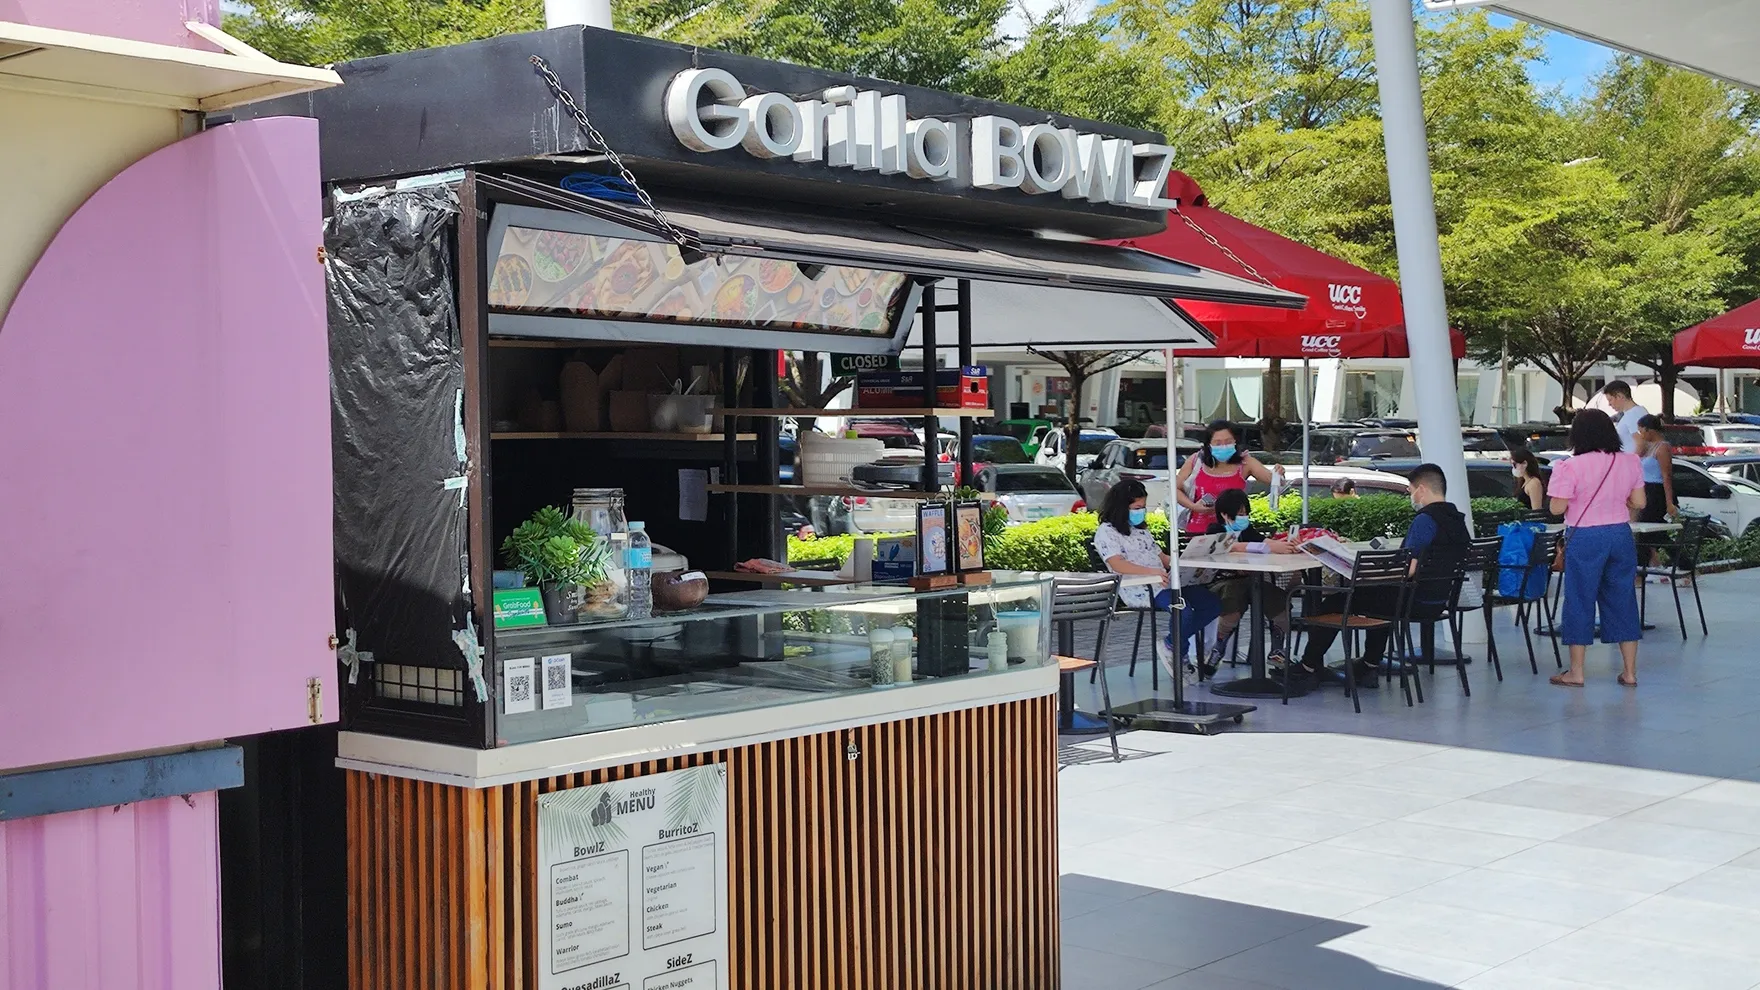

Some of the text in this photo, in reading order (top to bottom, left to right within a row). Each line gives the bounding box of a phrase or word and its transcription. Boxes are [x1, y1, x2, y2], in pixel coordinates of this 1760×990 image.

[667, 67, 1178, 210] Gorilla BOWLZ
[1328, 283, 1362, 304] UCC
[1301, 335, 1341, 348] UCC
[841, 355, 888, 370] CLOSED
[923, 510, 944, 518] WAFFLE
[503, 600, 531, 609] GrabFood
[629, 788, 656, 799] Healthy
[616, 795, 656, 816] MENU
[658, 822, 699, 840] BurritoZ
[573, 841, 605, 858] BowlZ
[646, 862, 664, 874] Vegan
[555, 873, 579, 885] Combat
[646, 881, 677, 895] Vegetarian
[555, 896, 579, 907] Buddha
[646, 902, 669, 914] Chicken
[555, 921, 573, 931] Sumo
[646, 922, 663, 933] Steak
[555, 944, 580, 956] Warrior
[666, 952, 693, 970] SideZ
[669, 977, 693, 988] Nuggets
